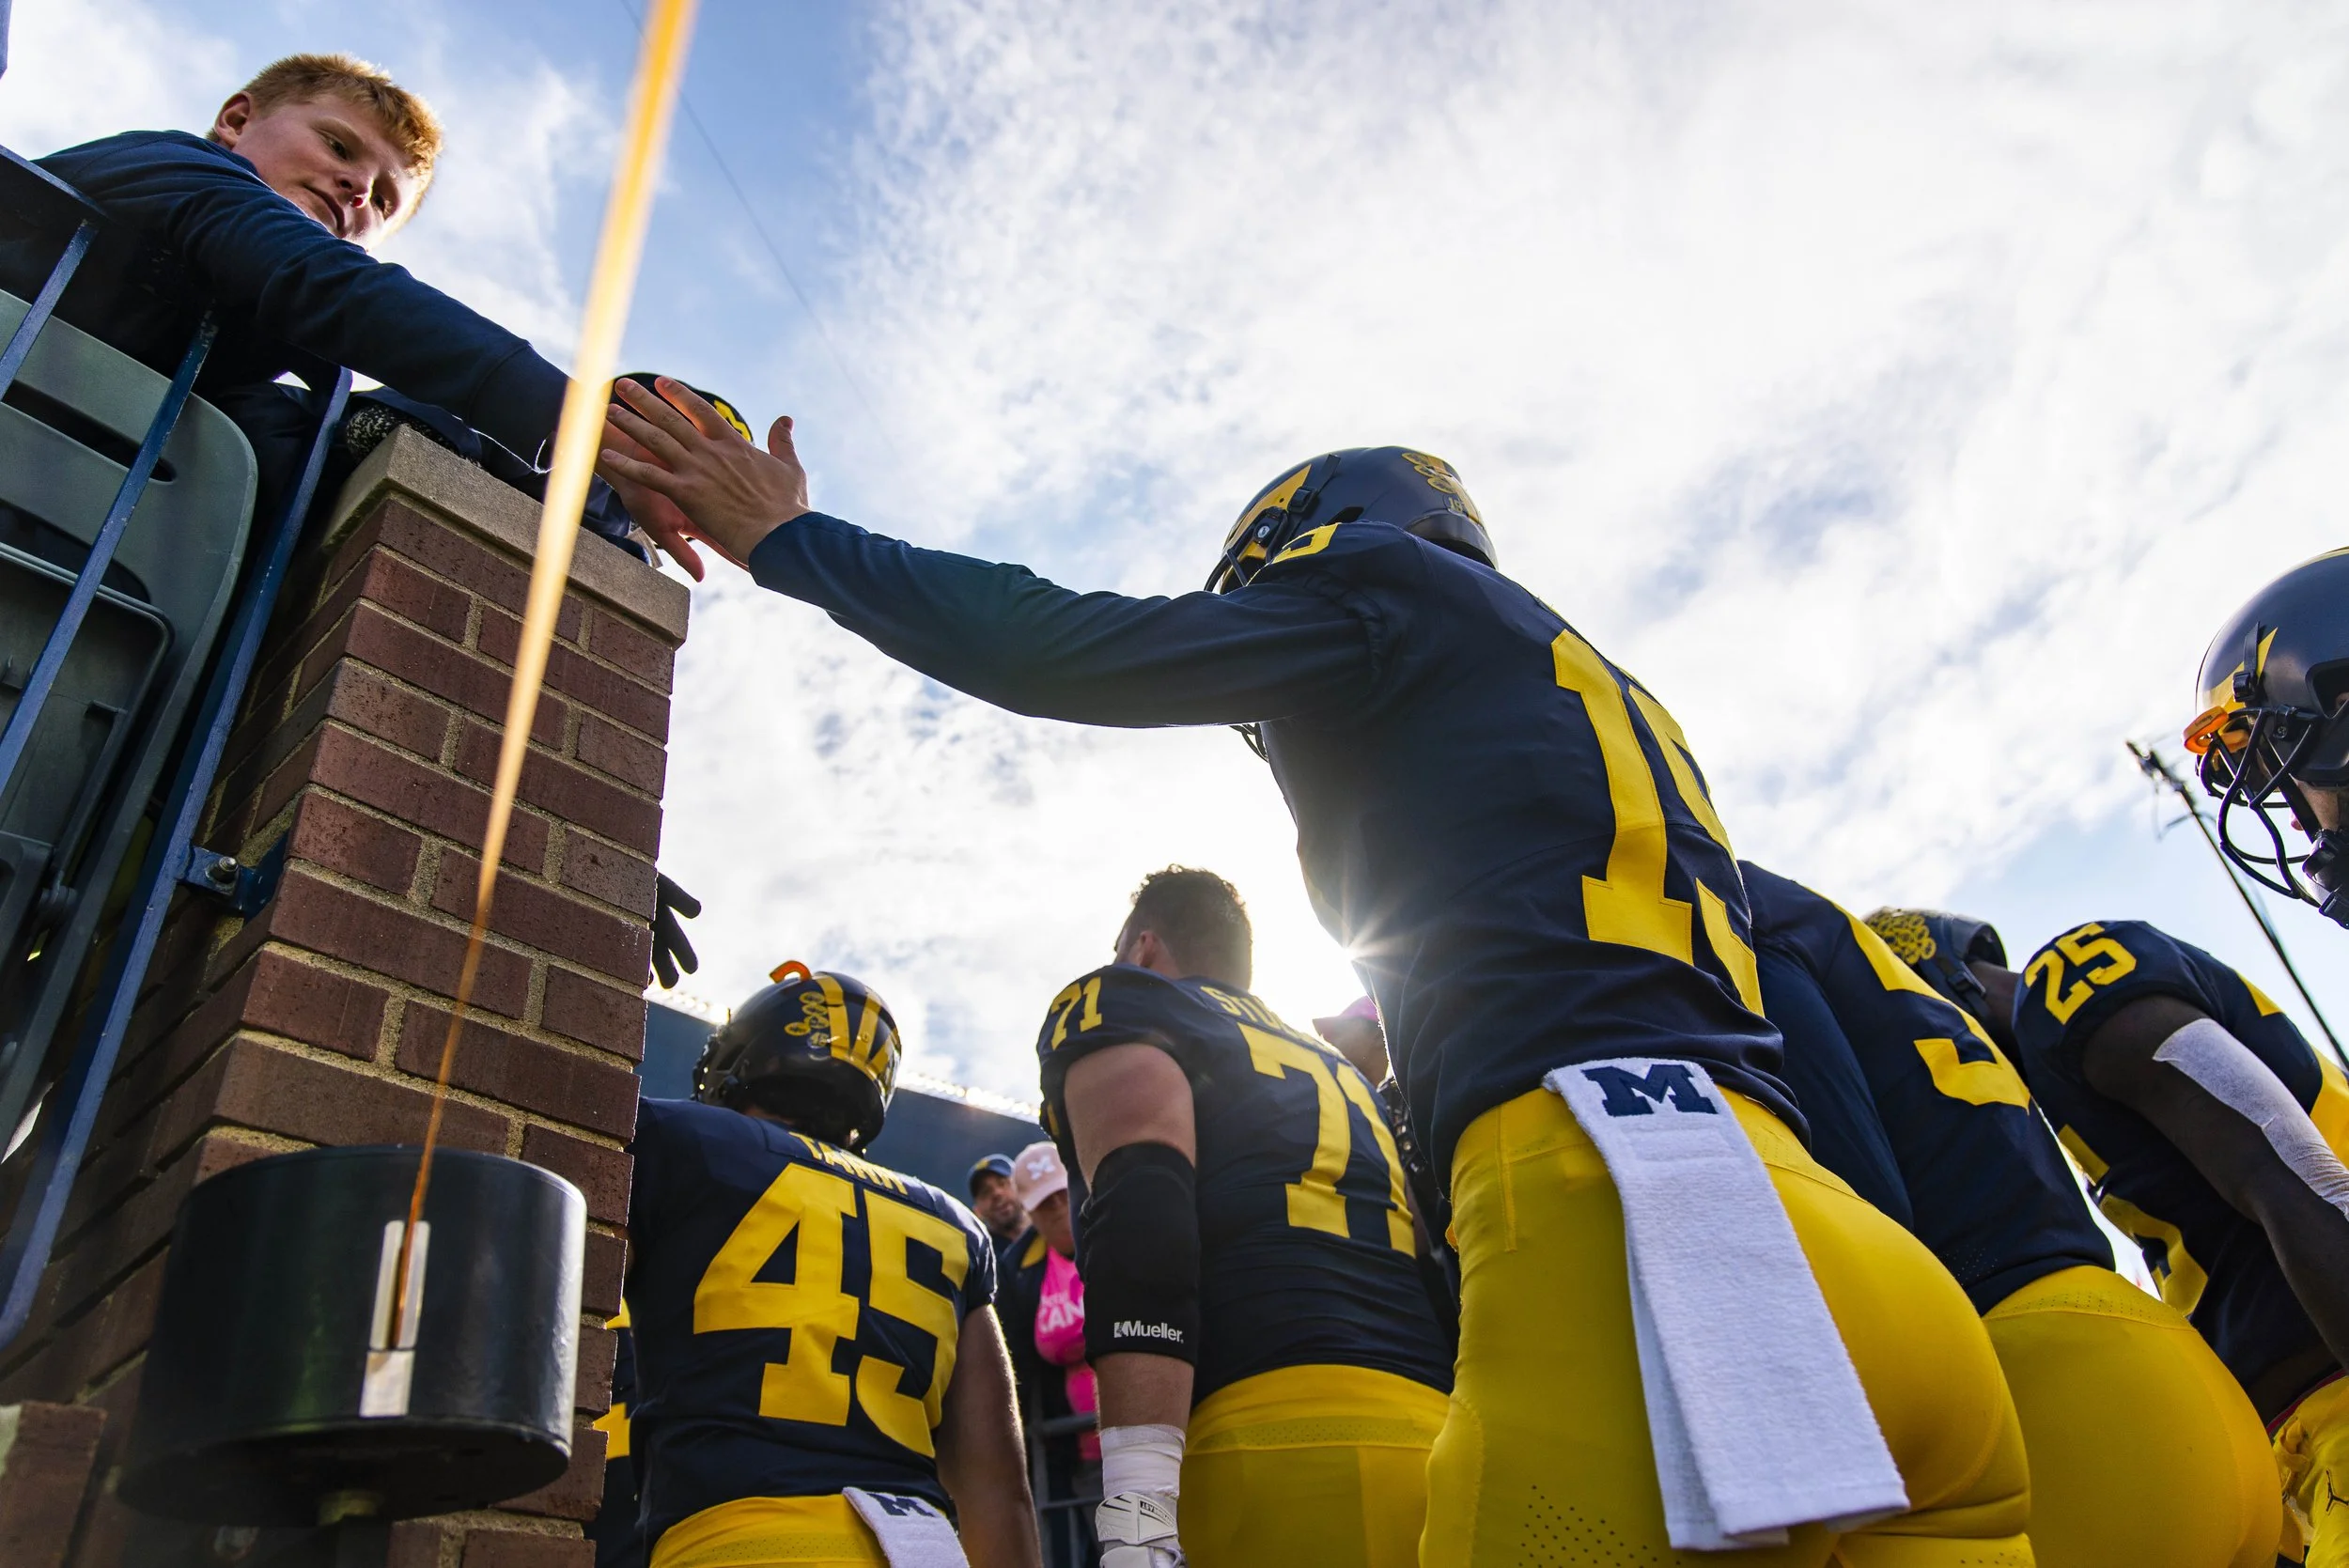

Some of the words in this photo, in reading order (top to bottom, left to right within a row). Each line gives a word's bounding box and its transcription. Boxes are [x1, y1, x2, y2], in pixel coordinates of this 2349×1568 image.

[1051, 976, 1102, 1051] 71
[2025, 922, 2137, 1025] 25
[1580, 1063, 1719, 1117] M
[1237, 1022, 1416, 1259] 71
[693, 1162, 968, 1458] 45
[1127, 1320, 1183, 1343] Mueller
